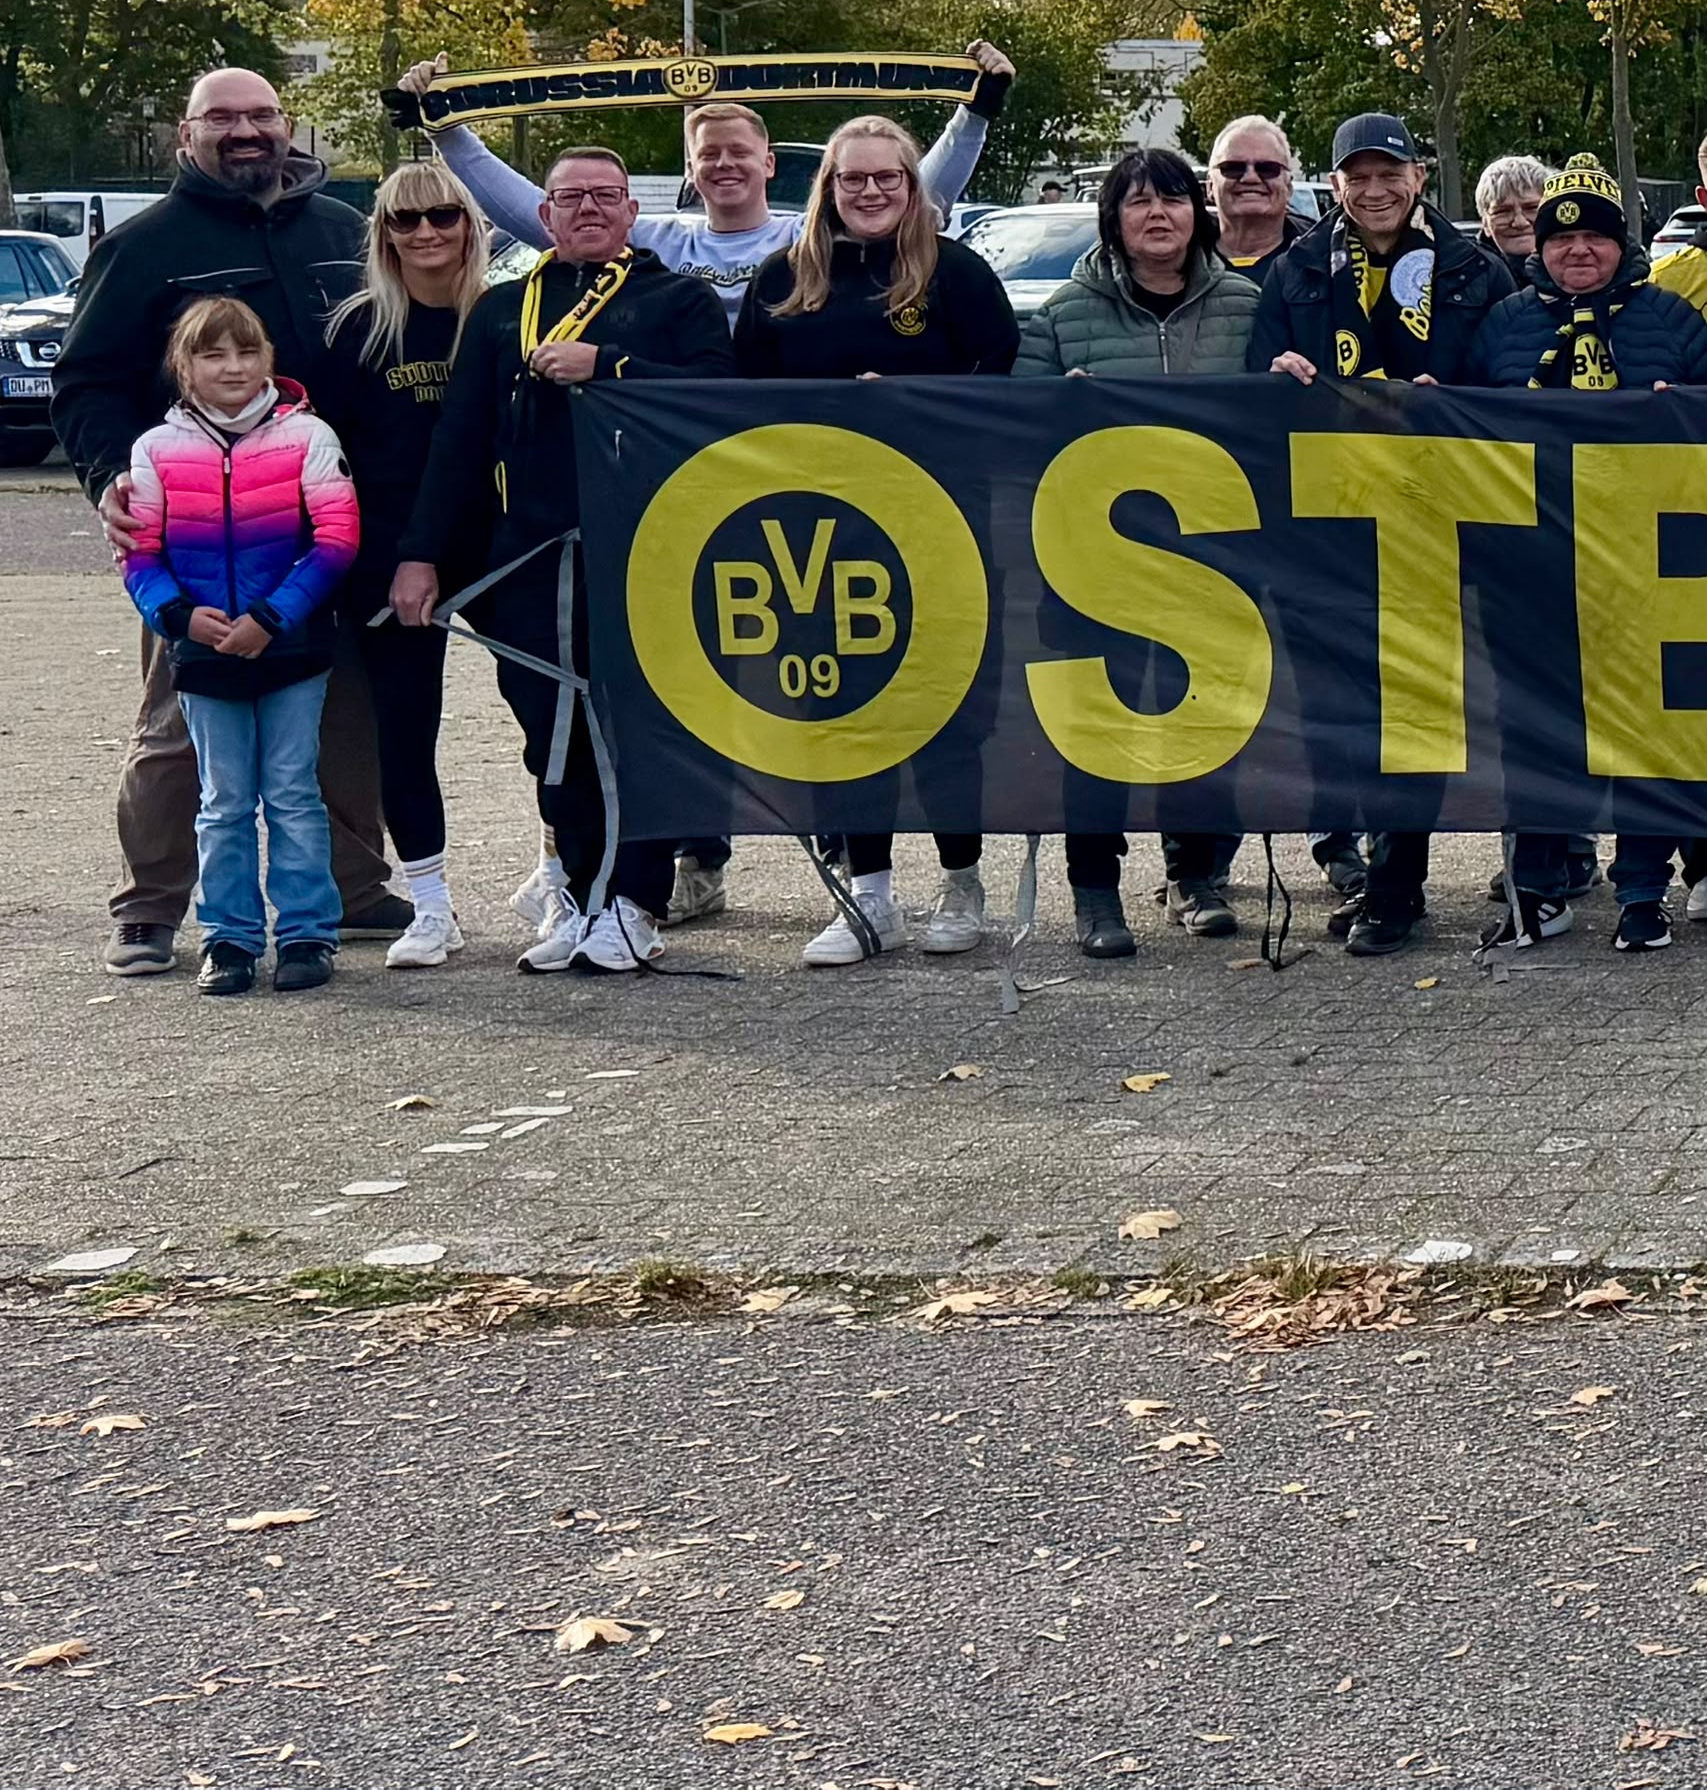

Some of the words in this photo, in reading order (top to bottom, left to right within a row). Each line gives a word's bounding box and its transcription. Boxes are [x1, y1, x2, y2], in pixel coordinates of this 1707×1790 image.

[671, 64, 710, 84] BVB
[1560, 204, 1576, 218] BVB
[1574, 342, 1614, 375] BVB
[11, 379, 25, 393] DU
[713, 518, 897, 656] BVB
[779, 653, 841, 699] 09
